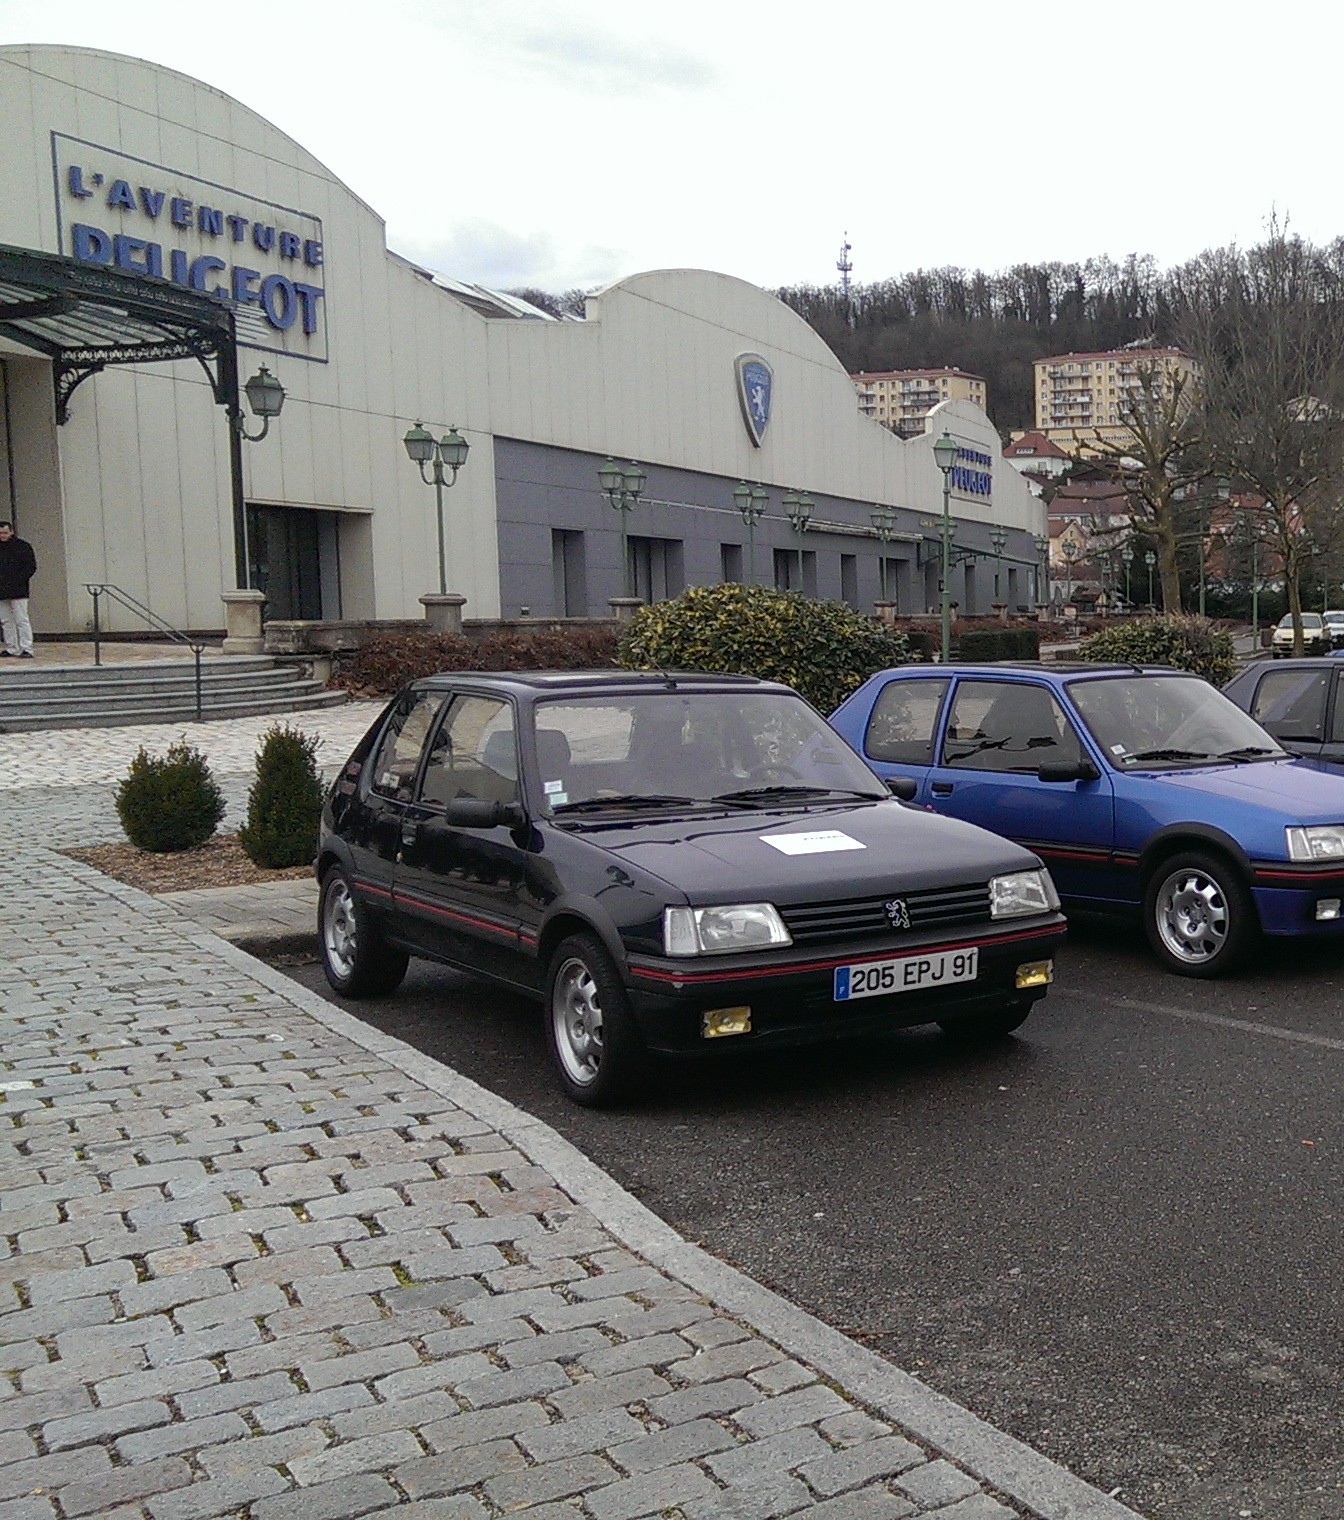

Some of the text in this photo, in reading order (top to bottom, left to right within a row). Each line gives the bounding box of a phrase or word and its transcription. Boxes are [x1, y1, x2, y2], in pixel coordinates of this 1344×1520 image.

[68, 165, 324, 268] L'AVENTURE
[951, 466, 992, 494] PEUGEOT
[851, 965, 895, 993] 205
[903, 957, 945, 985] EPJ
[952, 953, 977, 977] 91
